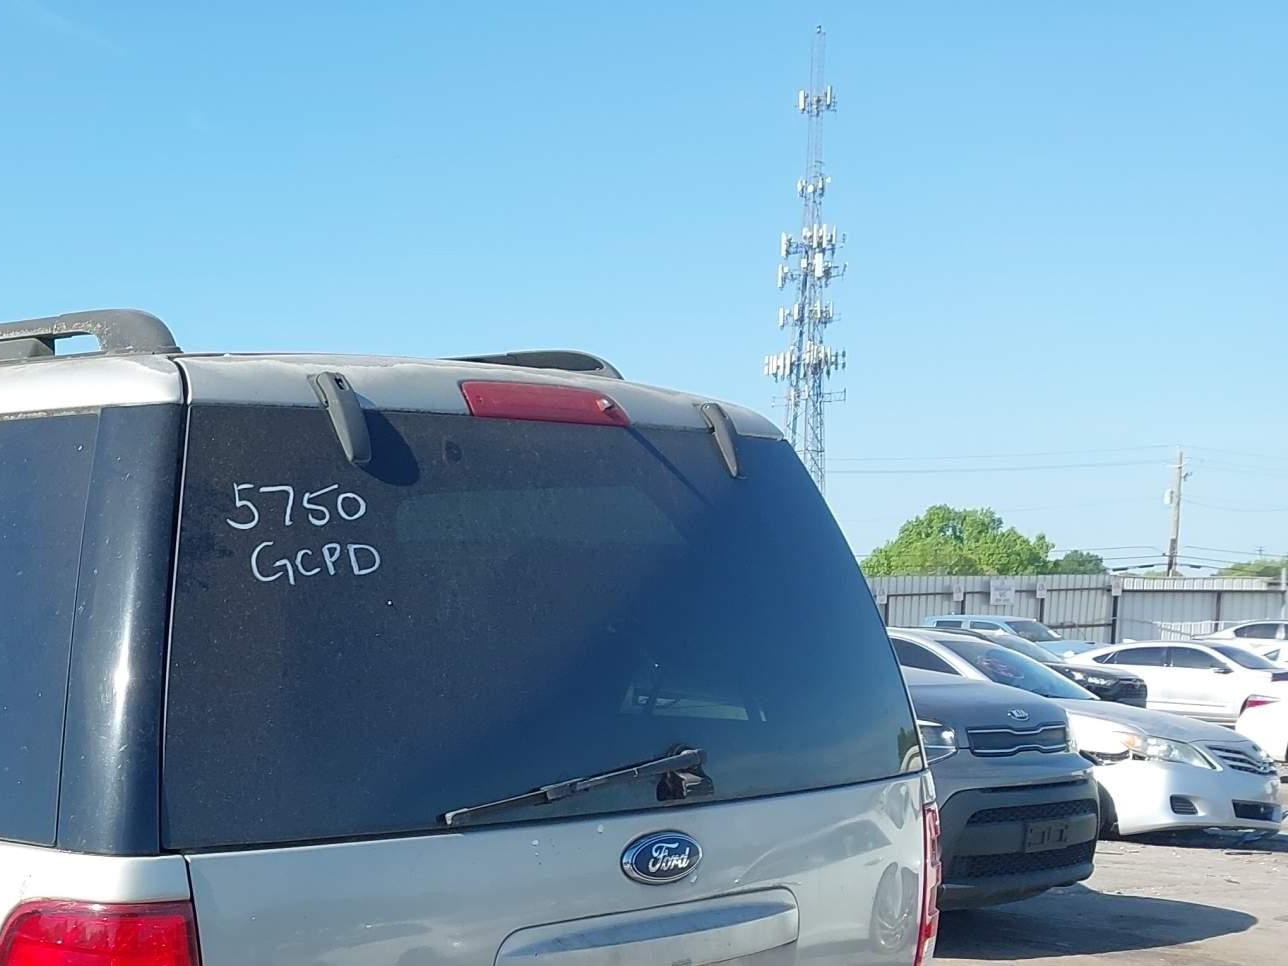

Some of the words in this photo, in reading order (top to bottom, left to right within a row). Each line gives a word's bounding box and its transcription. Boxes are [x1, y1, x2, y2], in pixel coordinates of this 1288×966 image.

[226, 482, 367, 530] 5750
[250, 541, 381, 586] GCPD
[648, 842, 690, 873] Ford
